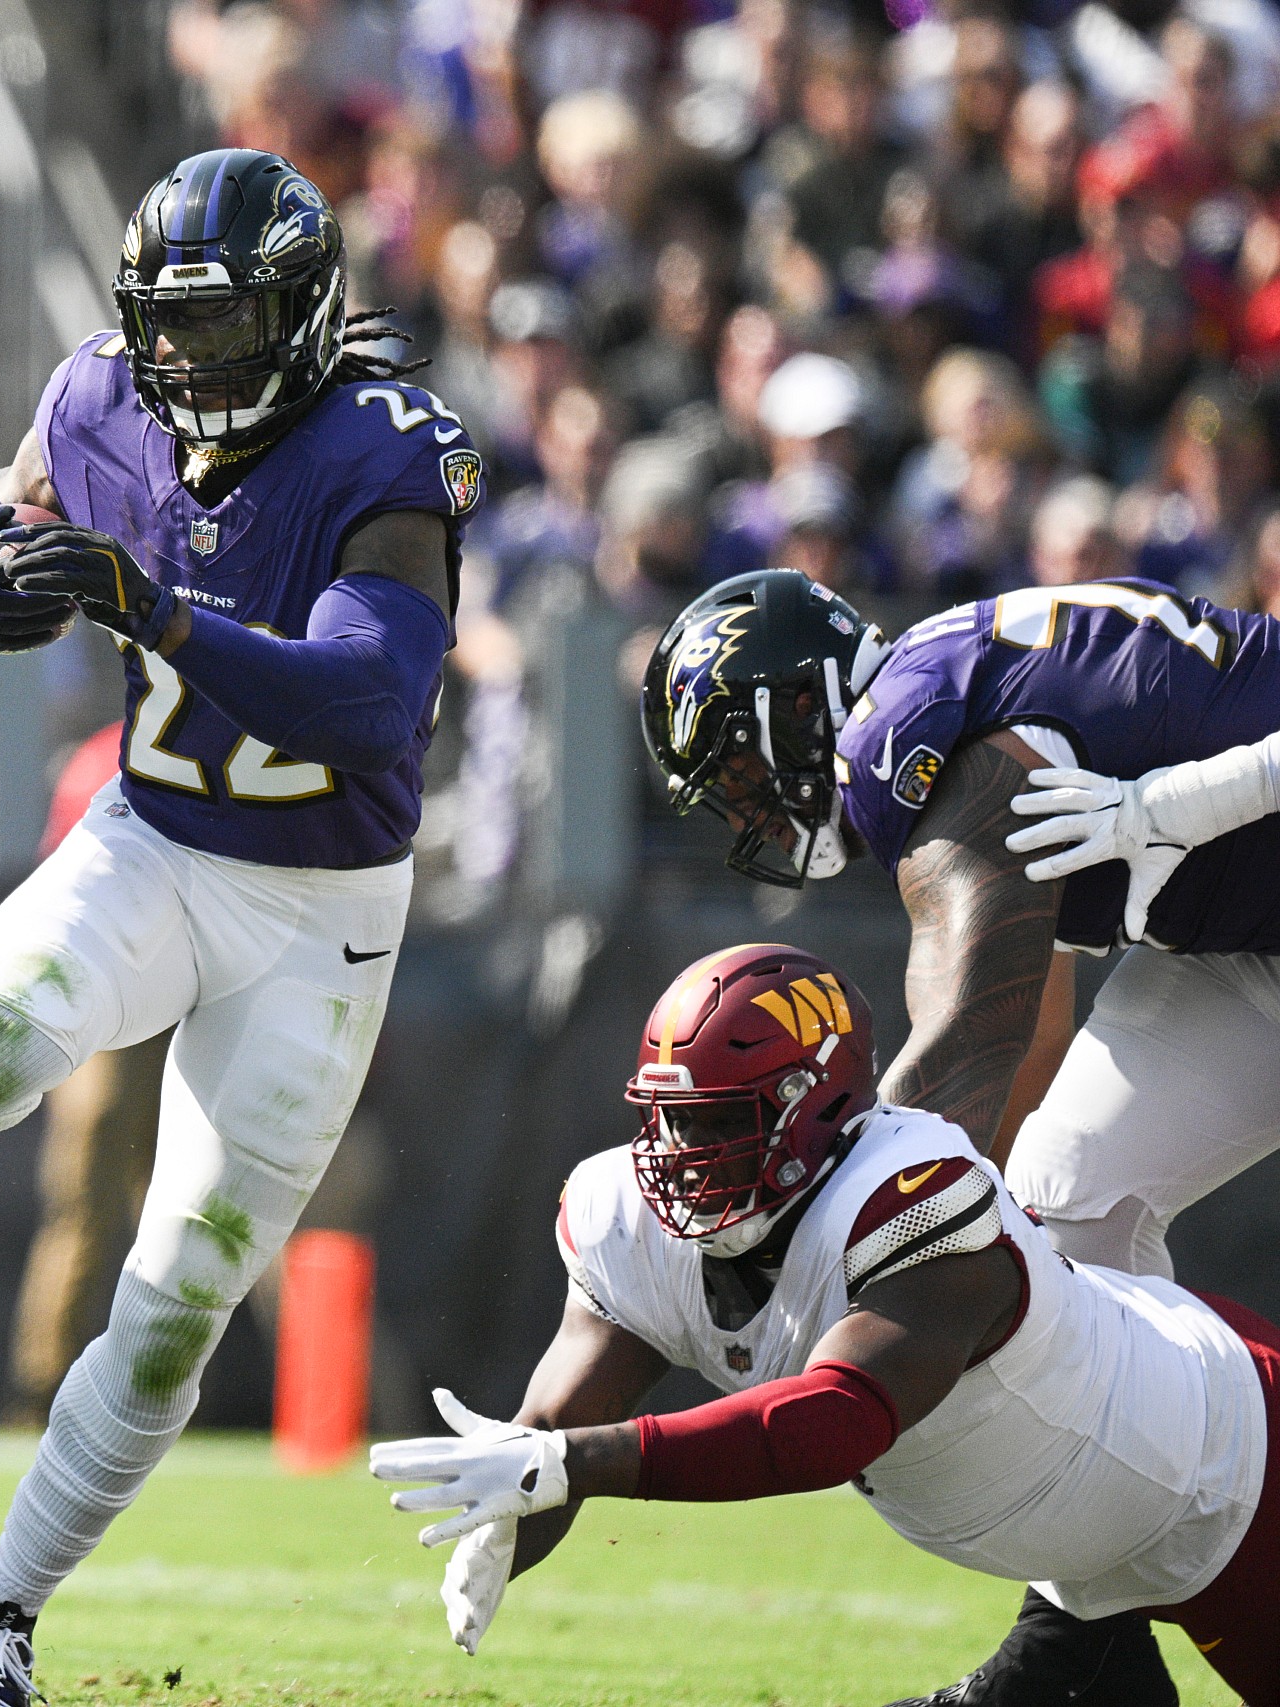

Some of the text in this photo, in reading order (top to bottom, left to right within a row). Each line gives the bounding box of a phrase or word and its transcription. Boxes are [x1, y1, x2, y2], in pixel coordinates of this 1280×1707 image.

[172, 267, 210, 279] RAVENS
[248, 275, 281, 284] OAKLEY
[447, 455, 478, 466] RAVENS
[194, 535, 212, 549] NFL
[172, 586, 237, 609] RAVENS
